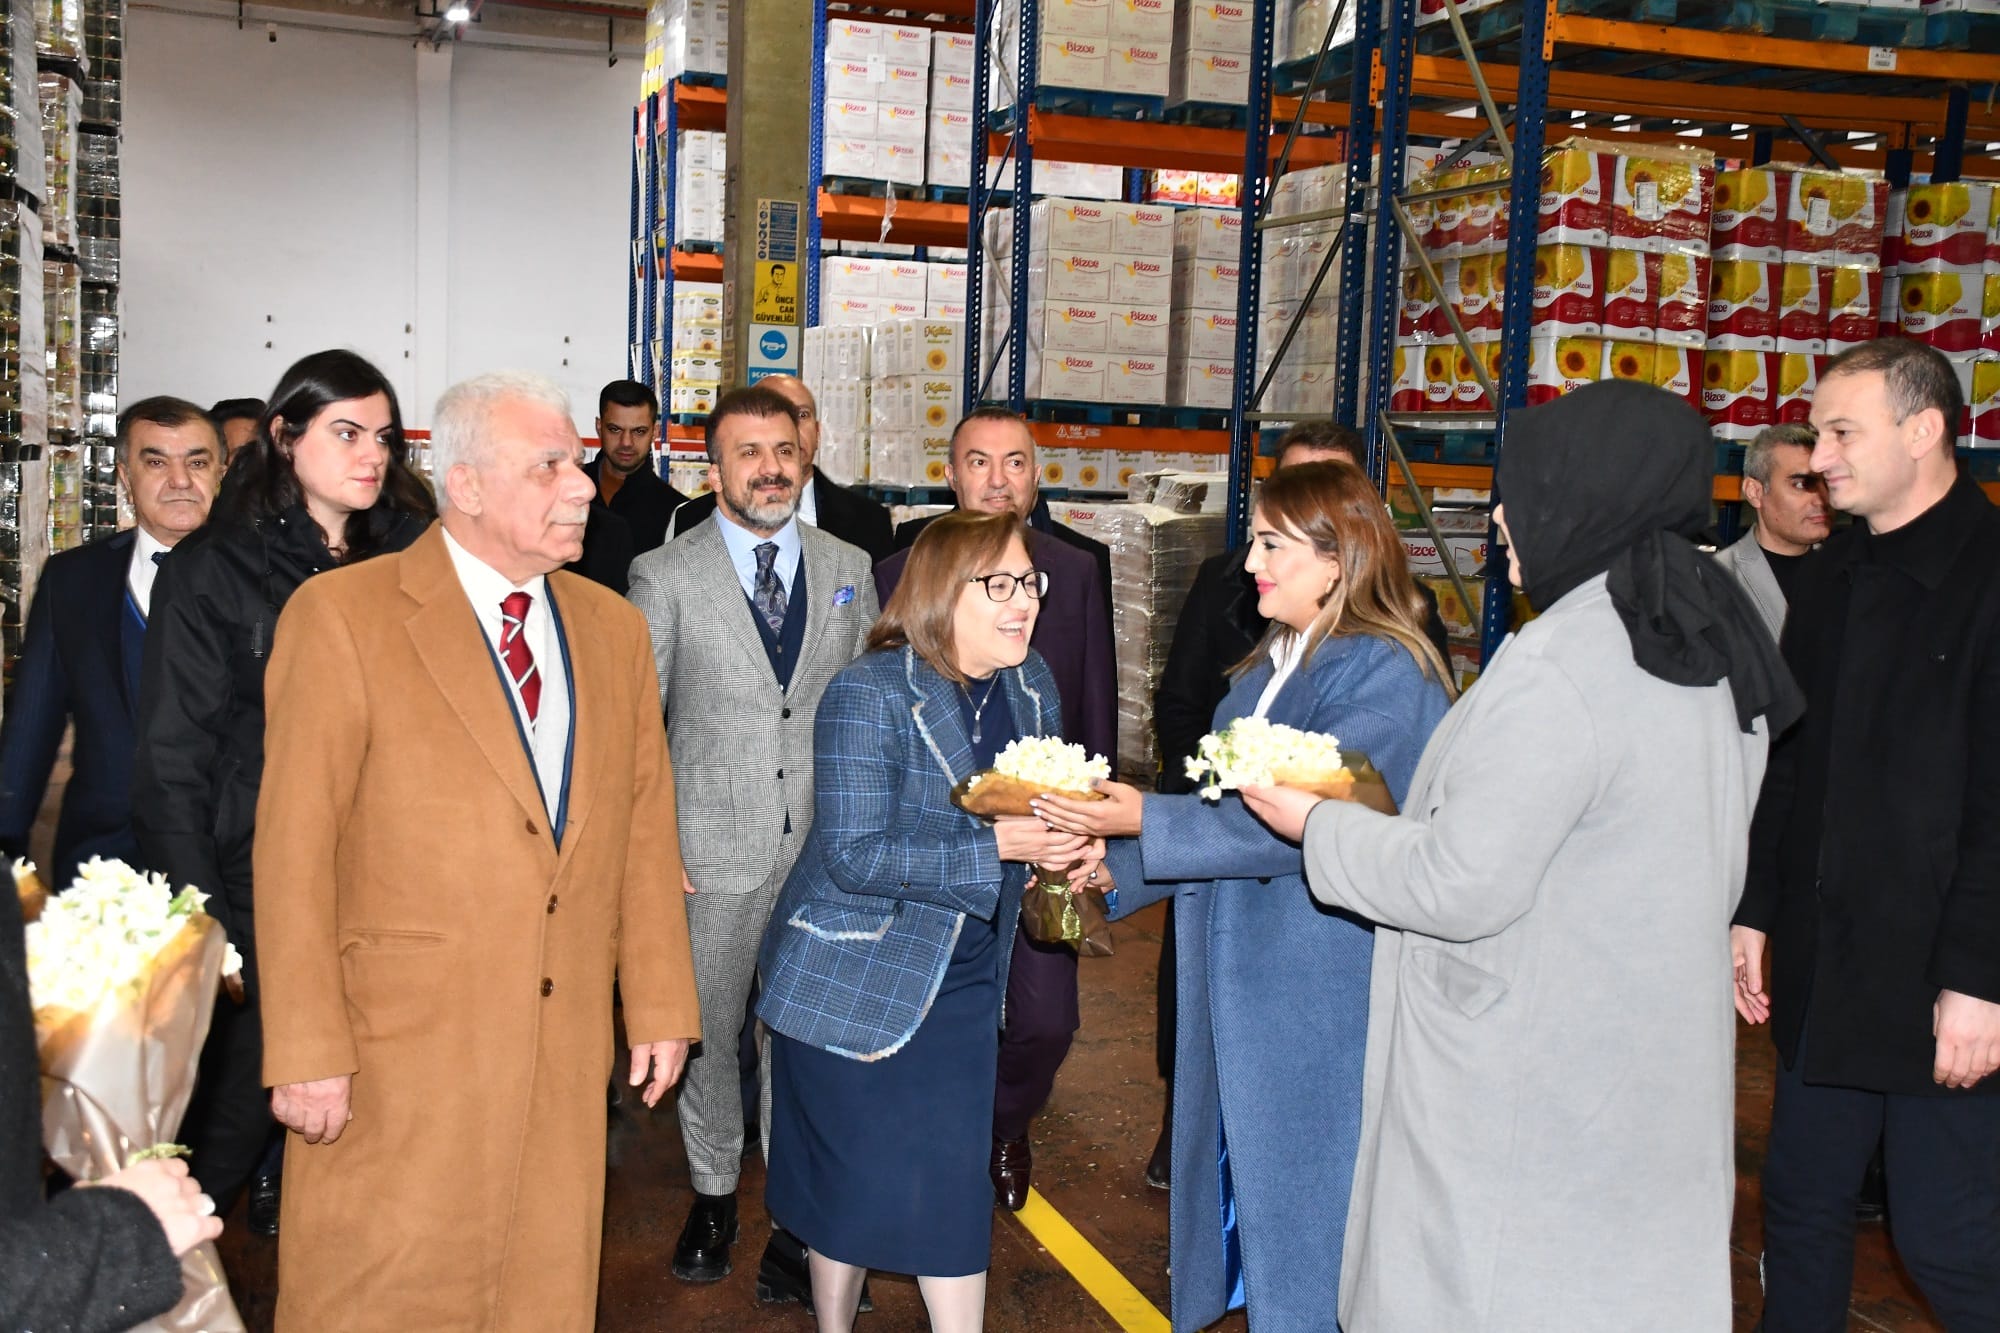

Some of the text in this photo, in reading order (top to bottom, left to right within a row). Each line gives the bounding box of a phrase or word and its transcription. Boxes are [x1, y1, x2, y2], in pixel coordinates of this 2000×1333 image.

[1215, 4, 1243, 17] Bizce
[1066, 41, 1095, 54] Bizce
[1130, 47, 1158, 60] Bizce
[1212, 56, 1239, 69] Bizce
[1073, 205, 1101, 218] Bizce
[1135, 210, 1162, 222] Bizce
[1071, 256, 1099, 269] Bizce
[1133, 260, 1160, 272] Bizce
[775, 295, 794, 304] ÖNCE
[779, 305, 794, 313] CAN
[1068, 307, 1096, 319] Bizce
[1130, 310, 1157, 322] Bizce
[1065, 357, 1093, 368] Bizce
[1127, 360, 1155, 371] Bizce
